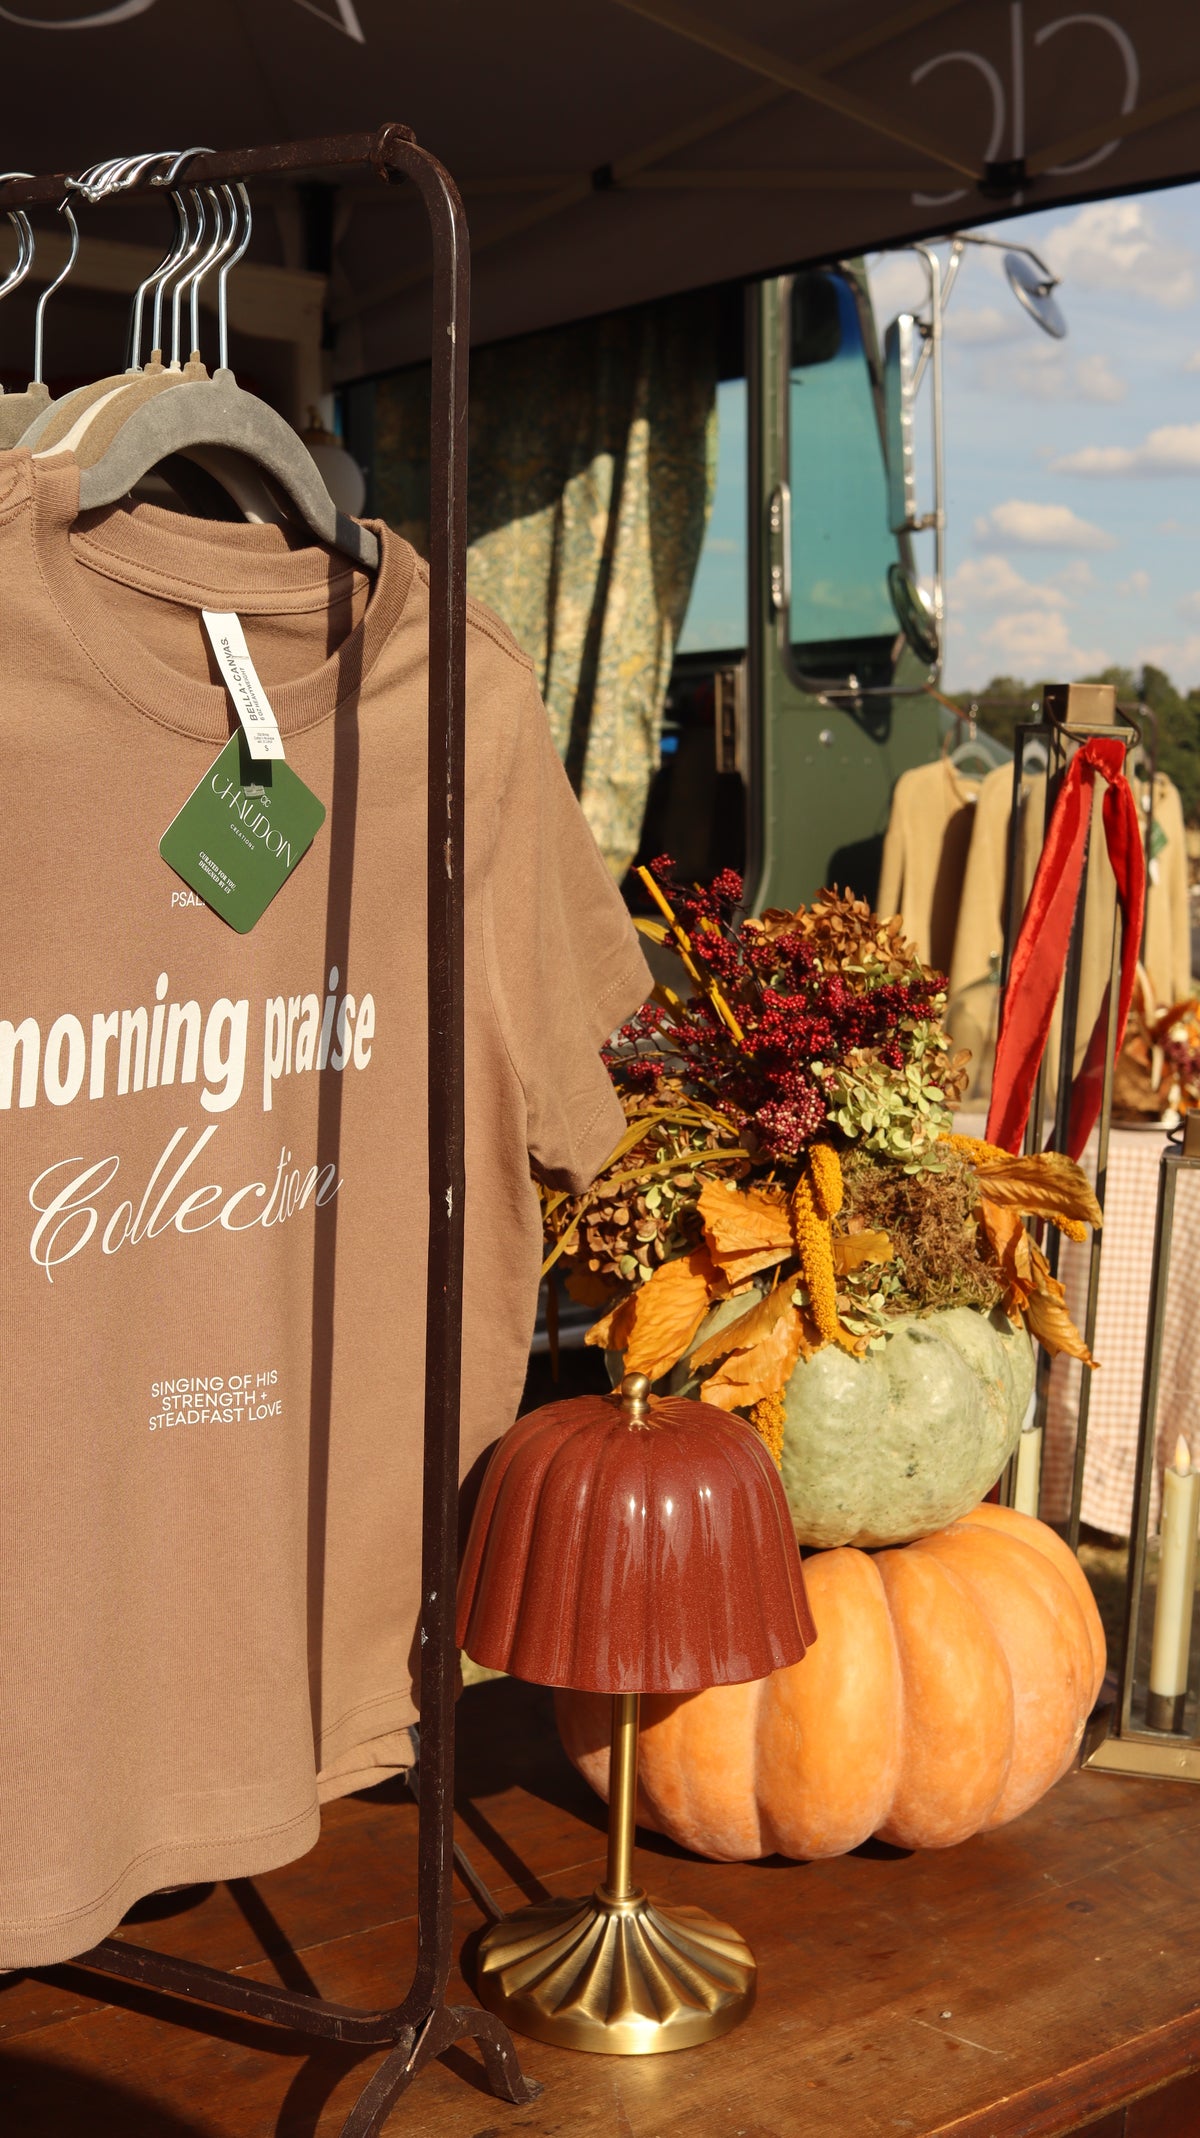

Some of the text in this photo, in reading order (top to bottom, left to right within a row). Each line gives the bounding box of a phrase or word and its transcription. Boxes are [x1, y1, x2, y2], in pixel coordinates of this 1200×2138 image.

[240, 667, 261, 708] HEAVYWEIGHT
[230, 823, 255, 850] CREATIONS
[198, 860, 220, 883] DESIGNED
[199, 851, 219, 873] CURATED
[217, 869, 228, 882] FOR
[171, 891, 205, 908] PSAL
[263, 966, 375, 1112] praise
[29, 1125, 344, 1283] Collection
[151, 1369, 278, 1398] SINGING OF HIS
[149, 1400, 282, 1431] STEADFAST LOVE
[162, 1390, 268, 1411] STRENGTH +
